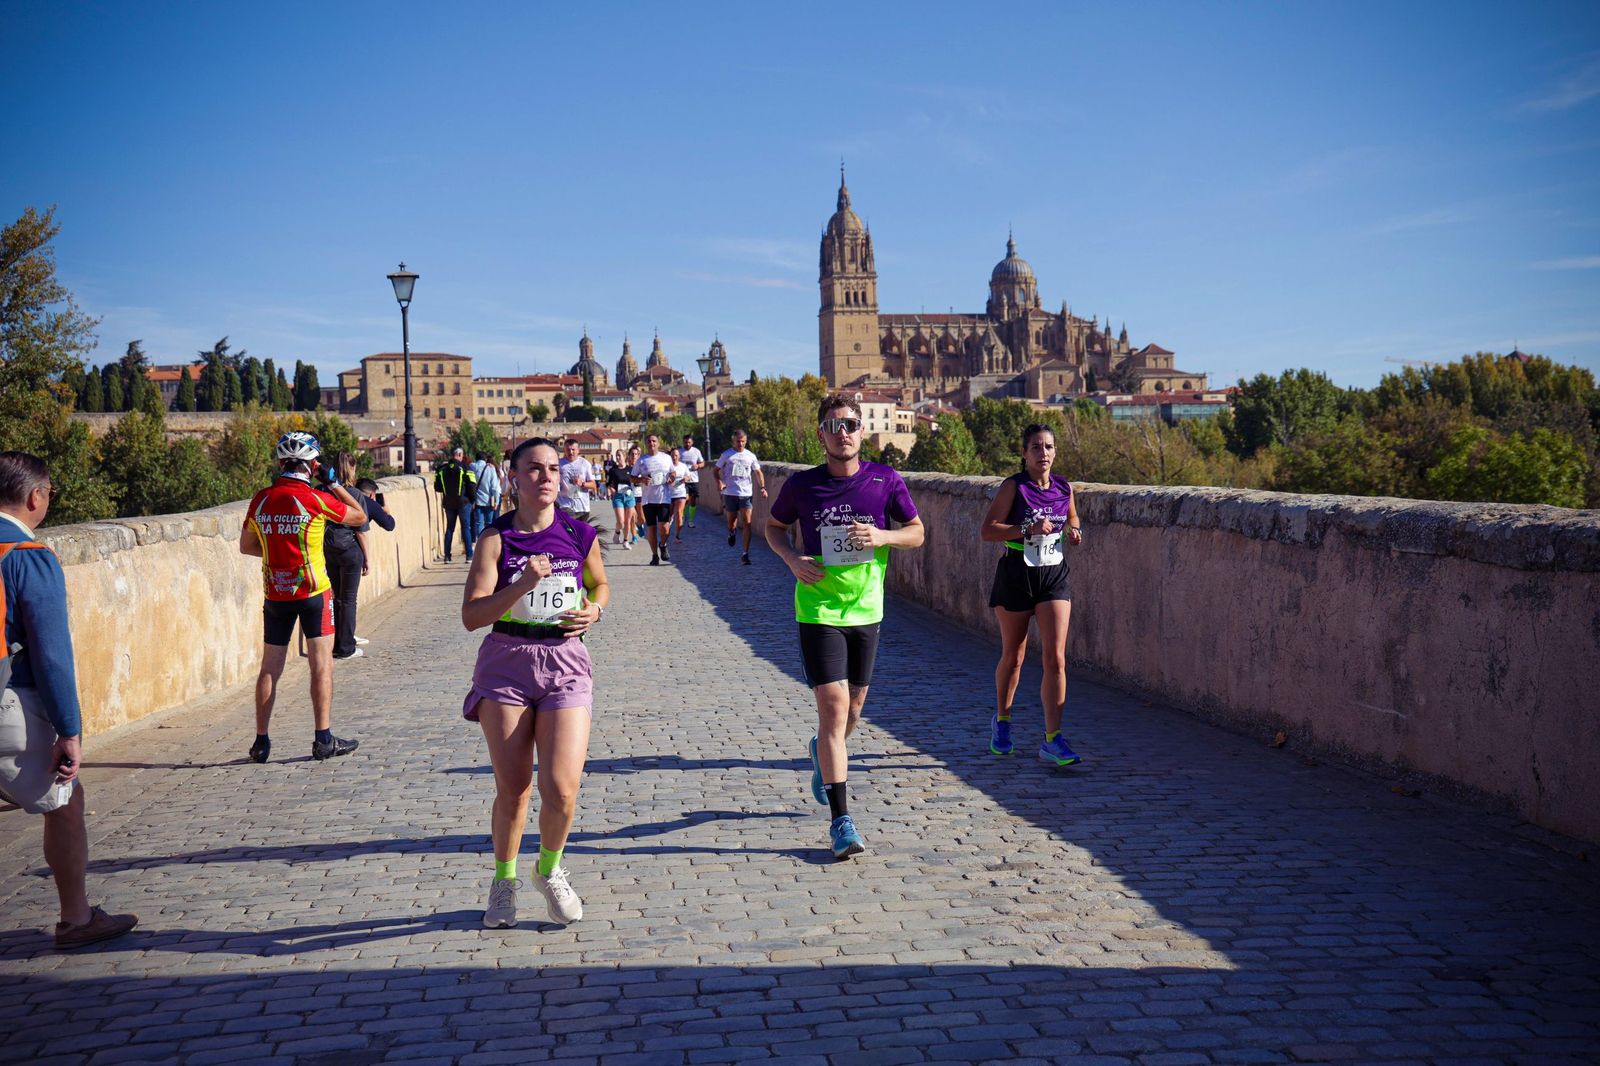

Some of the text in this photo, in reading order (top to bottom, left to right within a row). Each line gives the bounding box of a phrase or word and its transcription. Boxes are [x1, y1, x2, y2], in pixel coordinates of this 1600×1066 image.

[274, 514, 309, 523] CICLISTA
[262, 523, 300, 535] LA RAD
[1034, 544, 1054, 556] 118
[527, 591, 563, 608] 116
